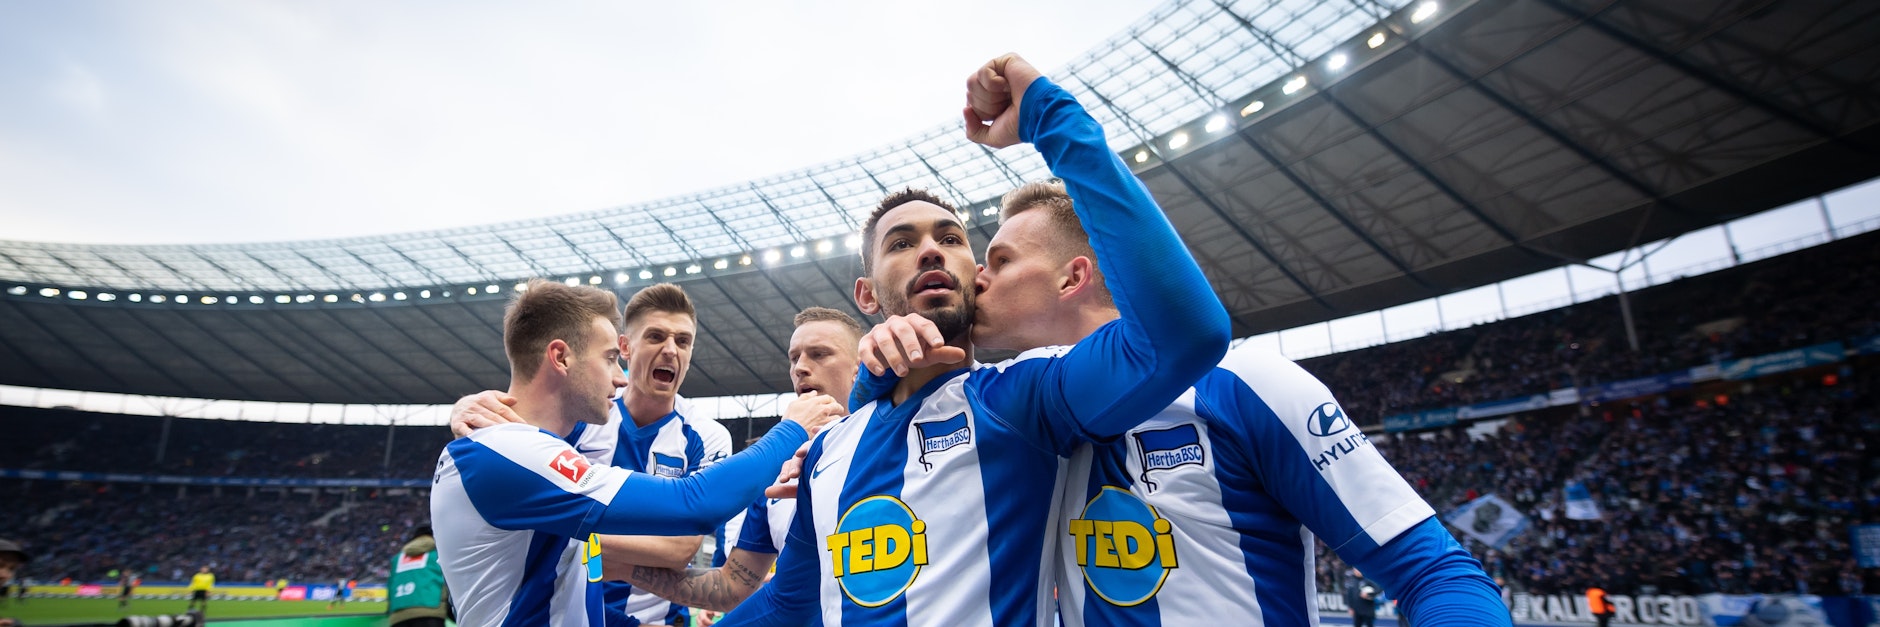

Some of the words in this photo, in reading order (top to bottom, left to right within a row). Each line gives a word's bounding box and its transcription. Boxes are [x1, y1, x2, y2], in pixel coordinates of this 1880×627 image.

[827, 519, 929, 578] TEDi
[1069, 518, 1179, 569] TEDi
[395, 581, 416, 598] 19
